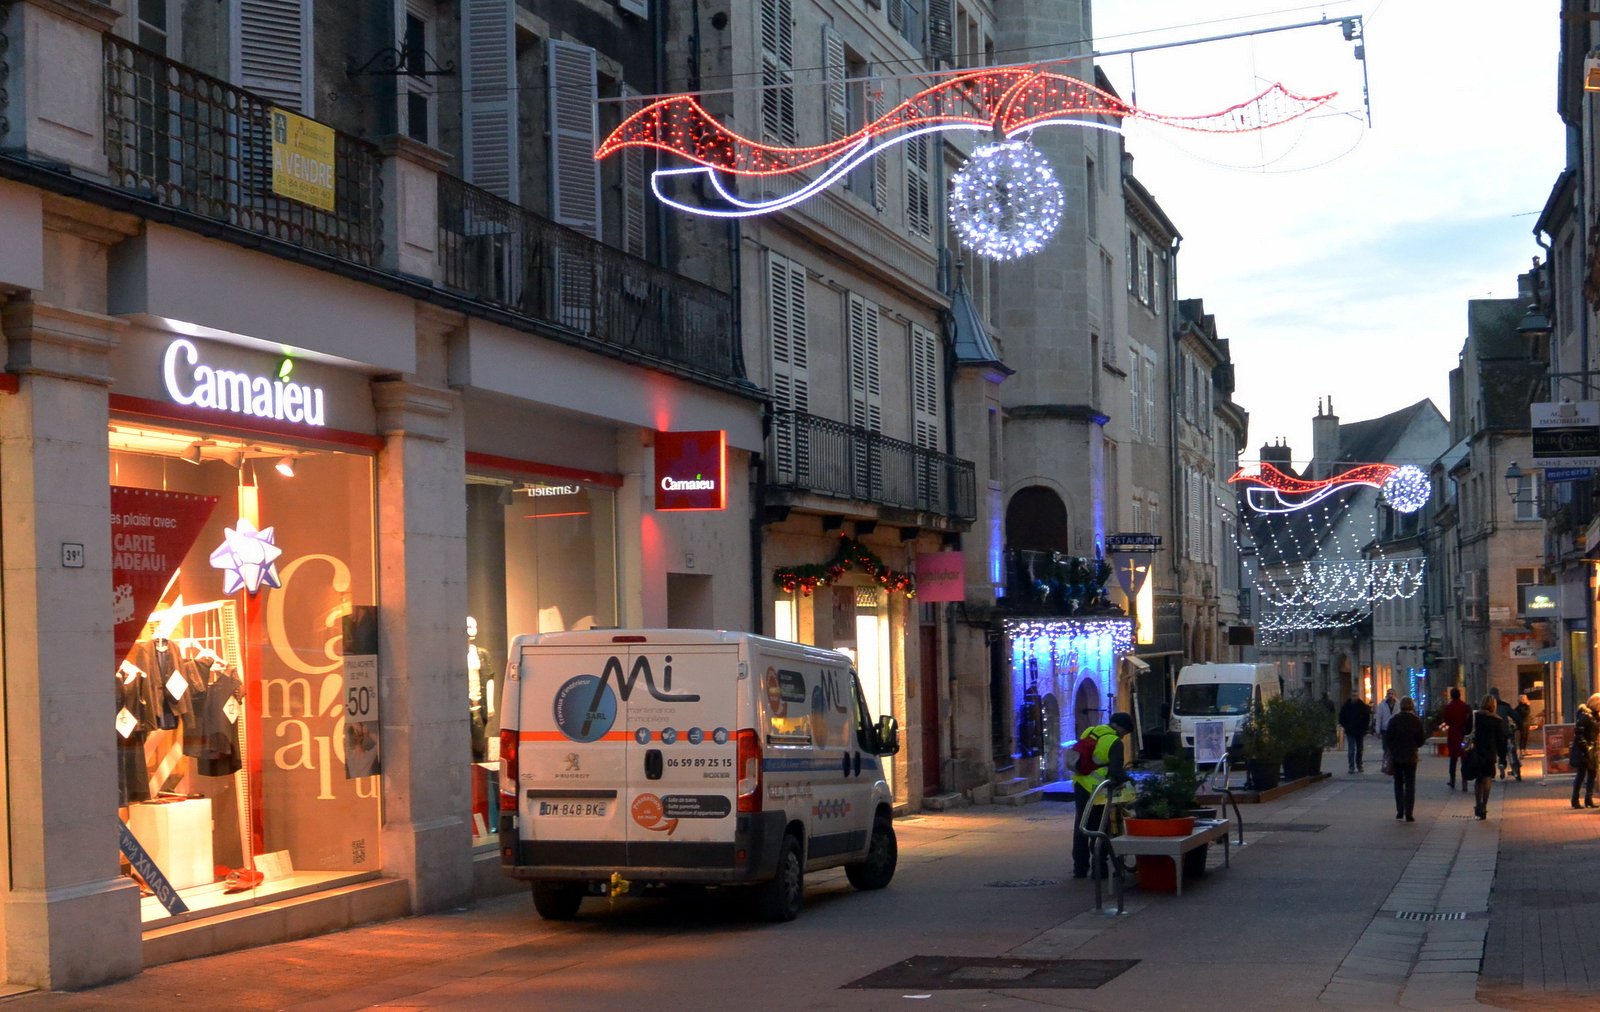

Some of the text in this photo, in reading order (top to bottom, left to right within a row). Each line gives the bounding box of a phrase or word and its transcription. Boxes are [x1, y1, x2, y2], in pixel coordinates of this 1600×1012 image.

[287, 152, 333, 189] VENDRE
[1547, 468, 1589, 479] mercerie
[123, 513, 151, 527] plaisir
[153, 517, 177, 528] avec
[114, 533, 156, 552] CARTE
[1104, 536, 1161, 545] RESTAURANT
[667, 758, 732, 767] 06 59 89 25 15
